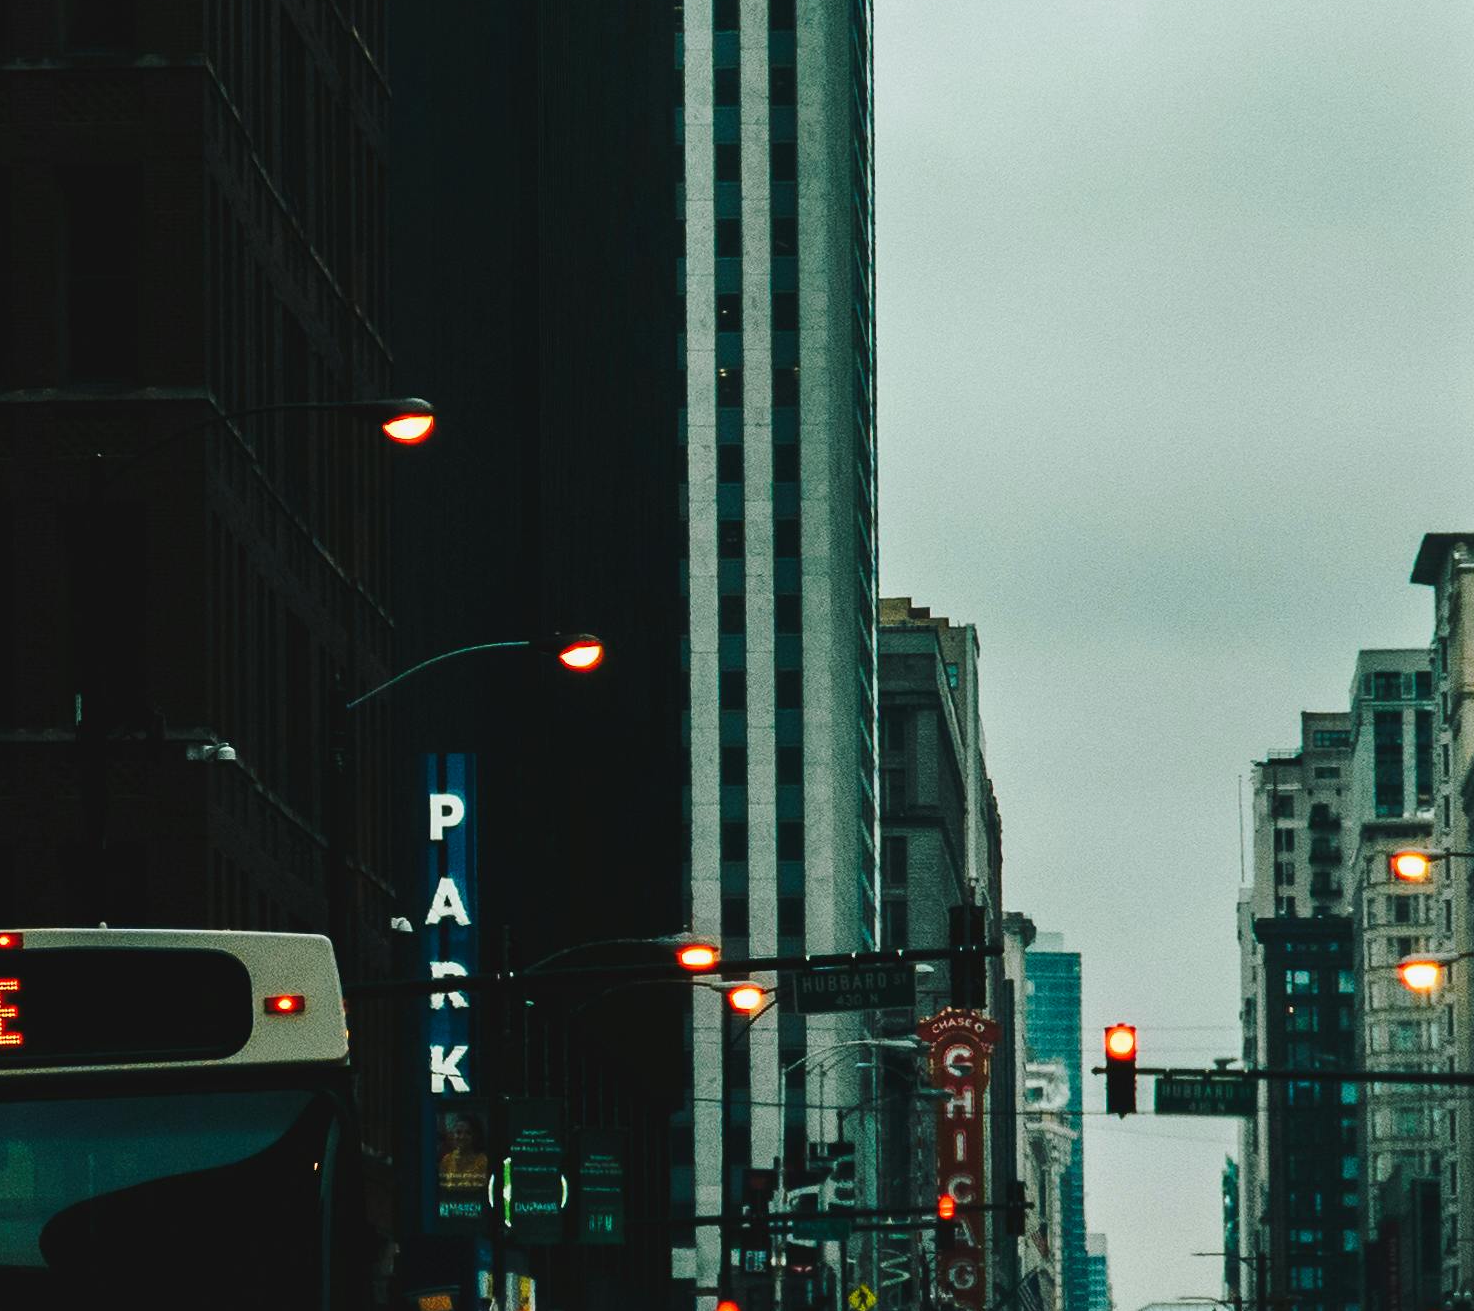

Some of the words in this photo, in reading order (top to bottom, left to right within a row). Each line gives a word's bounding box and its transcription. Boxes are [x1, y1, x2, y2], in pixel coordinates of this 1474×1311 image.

[424, 792, 472, 1094] PARK
[802, 971, 887, 993] HUBBARD
[931, 1016, 973, 1034] CHASE
